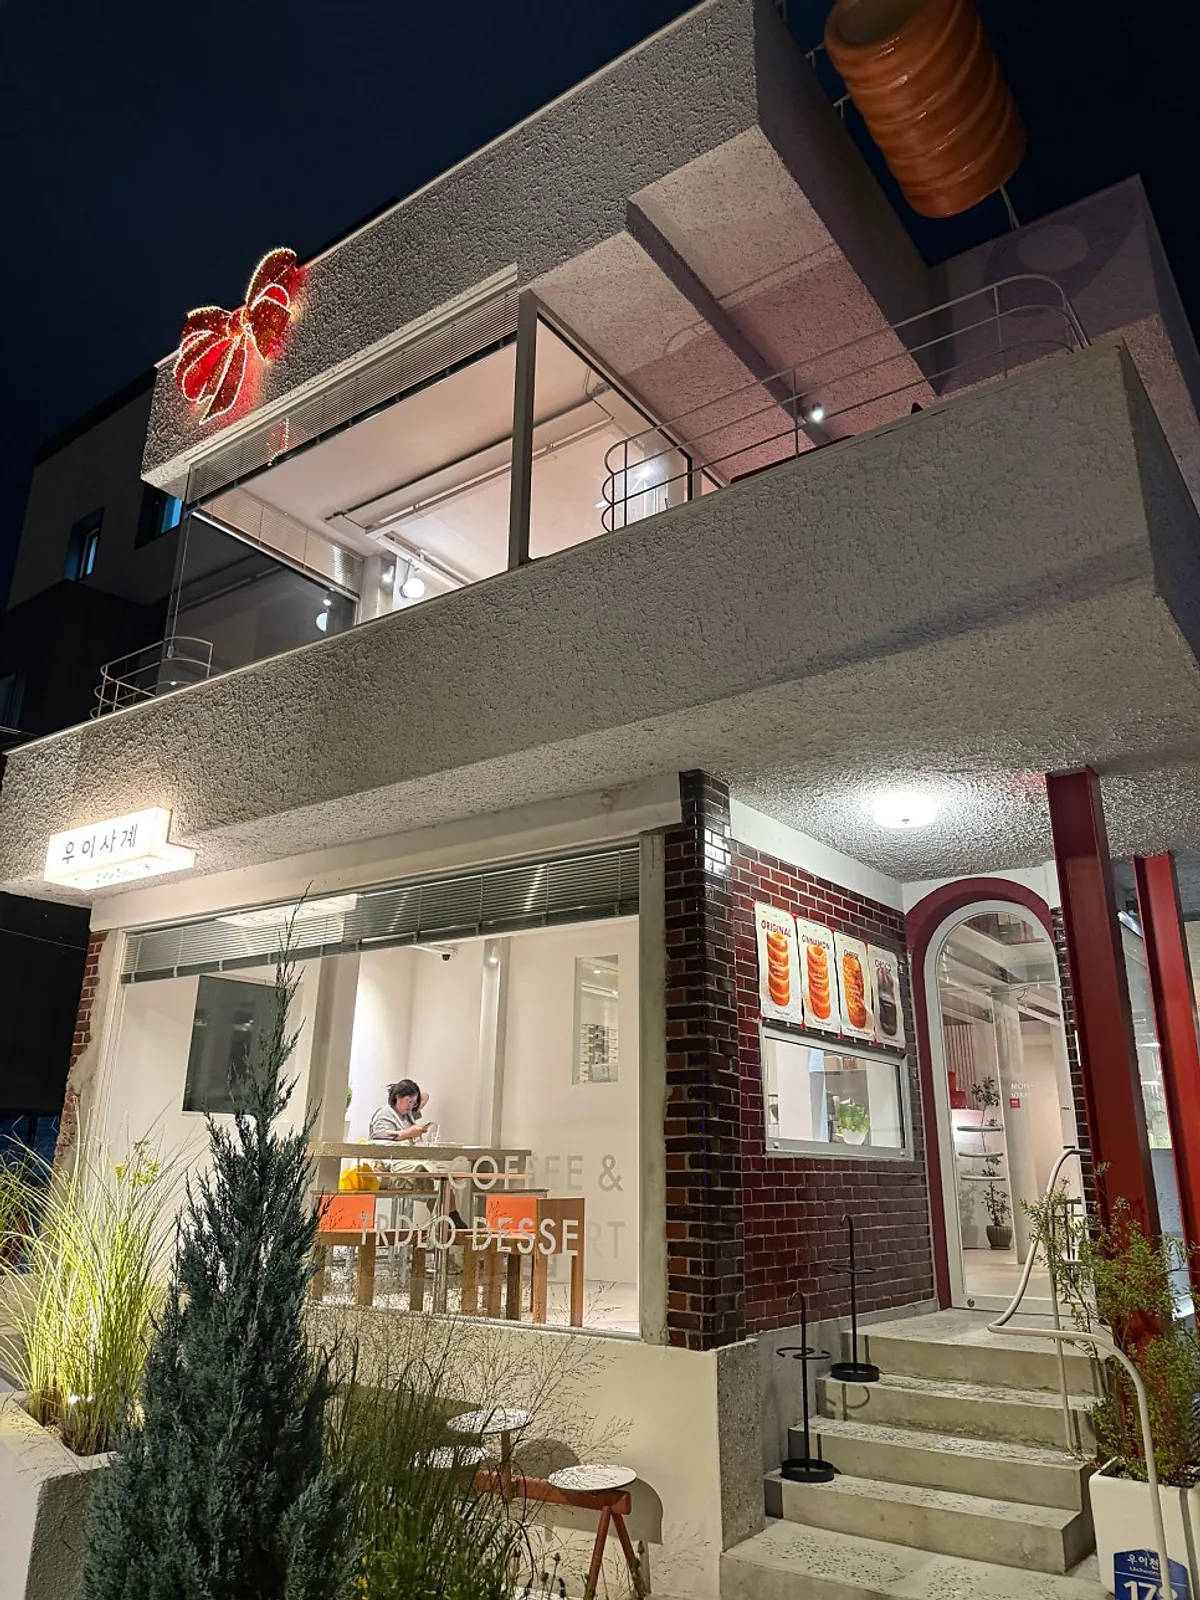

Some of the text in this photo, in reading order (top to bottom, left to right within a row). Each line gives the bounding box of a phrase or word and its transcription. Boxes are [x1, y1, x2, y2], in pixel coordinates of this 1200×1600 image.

[62, 823, 138, 864] 우이사계
[760, 919, 792, 938] ORIGINAL
[448, 1154, 624, 1193] COFFEE &
[359, 1212, 626, 1260] TRDLO DESSERT
[1126, 1553, 1160, 1571] 우이천
